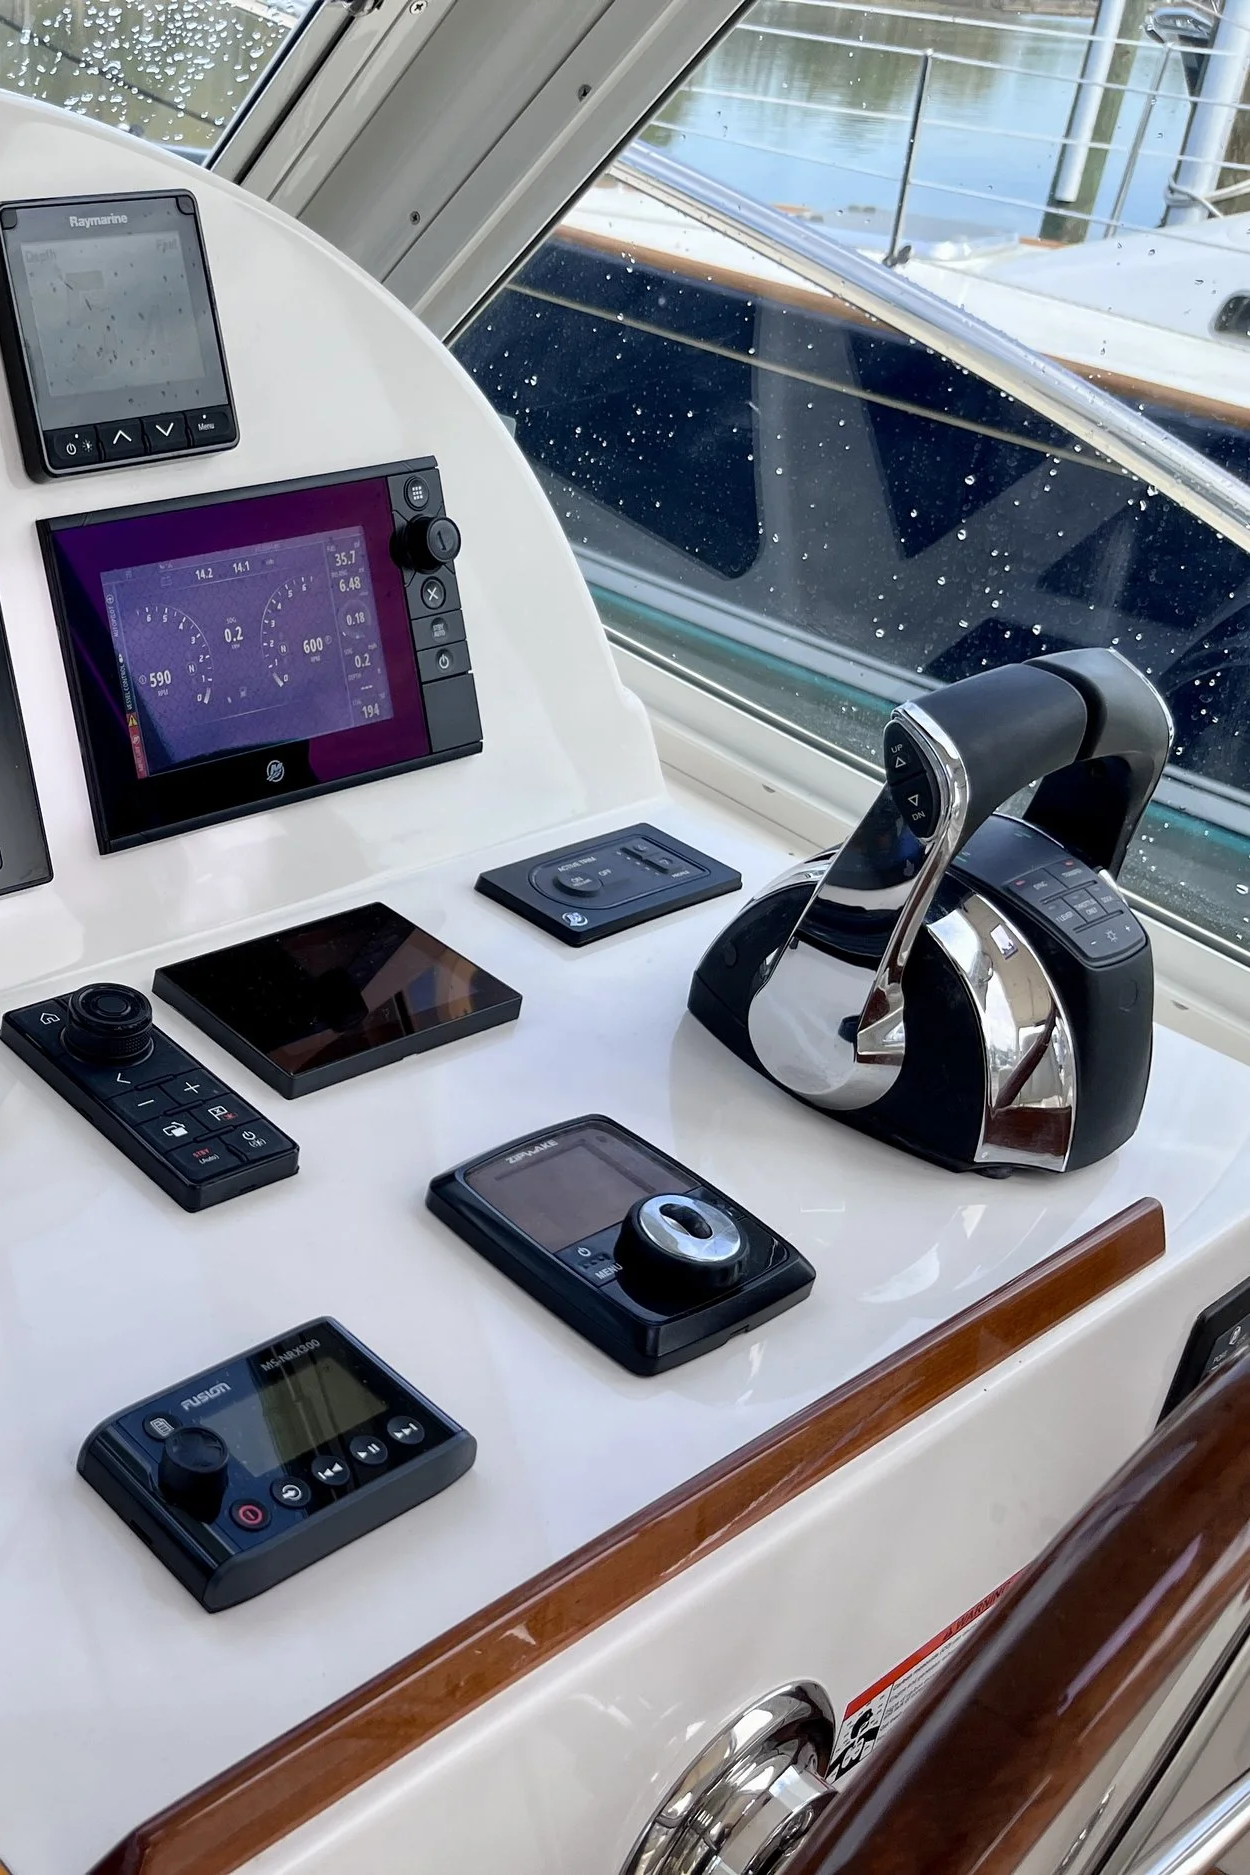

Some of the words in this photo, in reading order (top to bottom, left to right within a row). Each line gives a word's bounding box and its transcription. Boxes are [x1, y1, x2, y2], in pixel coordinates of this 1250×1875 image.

[69, 213, 128, 229] Raymarine
[198, 421, 215, 432] Menu
[334, 550, 357, 567] 35.7
[195, 567, 214, 581] 14.2
[232, 561, 251, 575] 14.1
[339, 576, 362, 593] 6.48
[109, 605, 120, 638] AUTOPILOT
[346, 611, 366, 626] 0.18
[224, 626, 244, 644] 0.2
[303, 636, 324, 654] 600
[354, 653, 372, 669] 0.2
[119, 664, 131, 691] CONTROL
[149, 669, 172, 688] 590
[124, 690, 134, 712] VESSEL
[361, 702, 380, 719] 194
[890, 743, 903, 756] UP
[911, 810, 926, 822] DN
[505, 1139, 558, 1165] ZIPWAKE
[595, 1261, 624, 1281] MENU
[260, 1338, 321, 1373] MS-NRX300
[181, 1382, 232, 1412] FUSION
